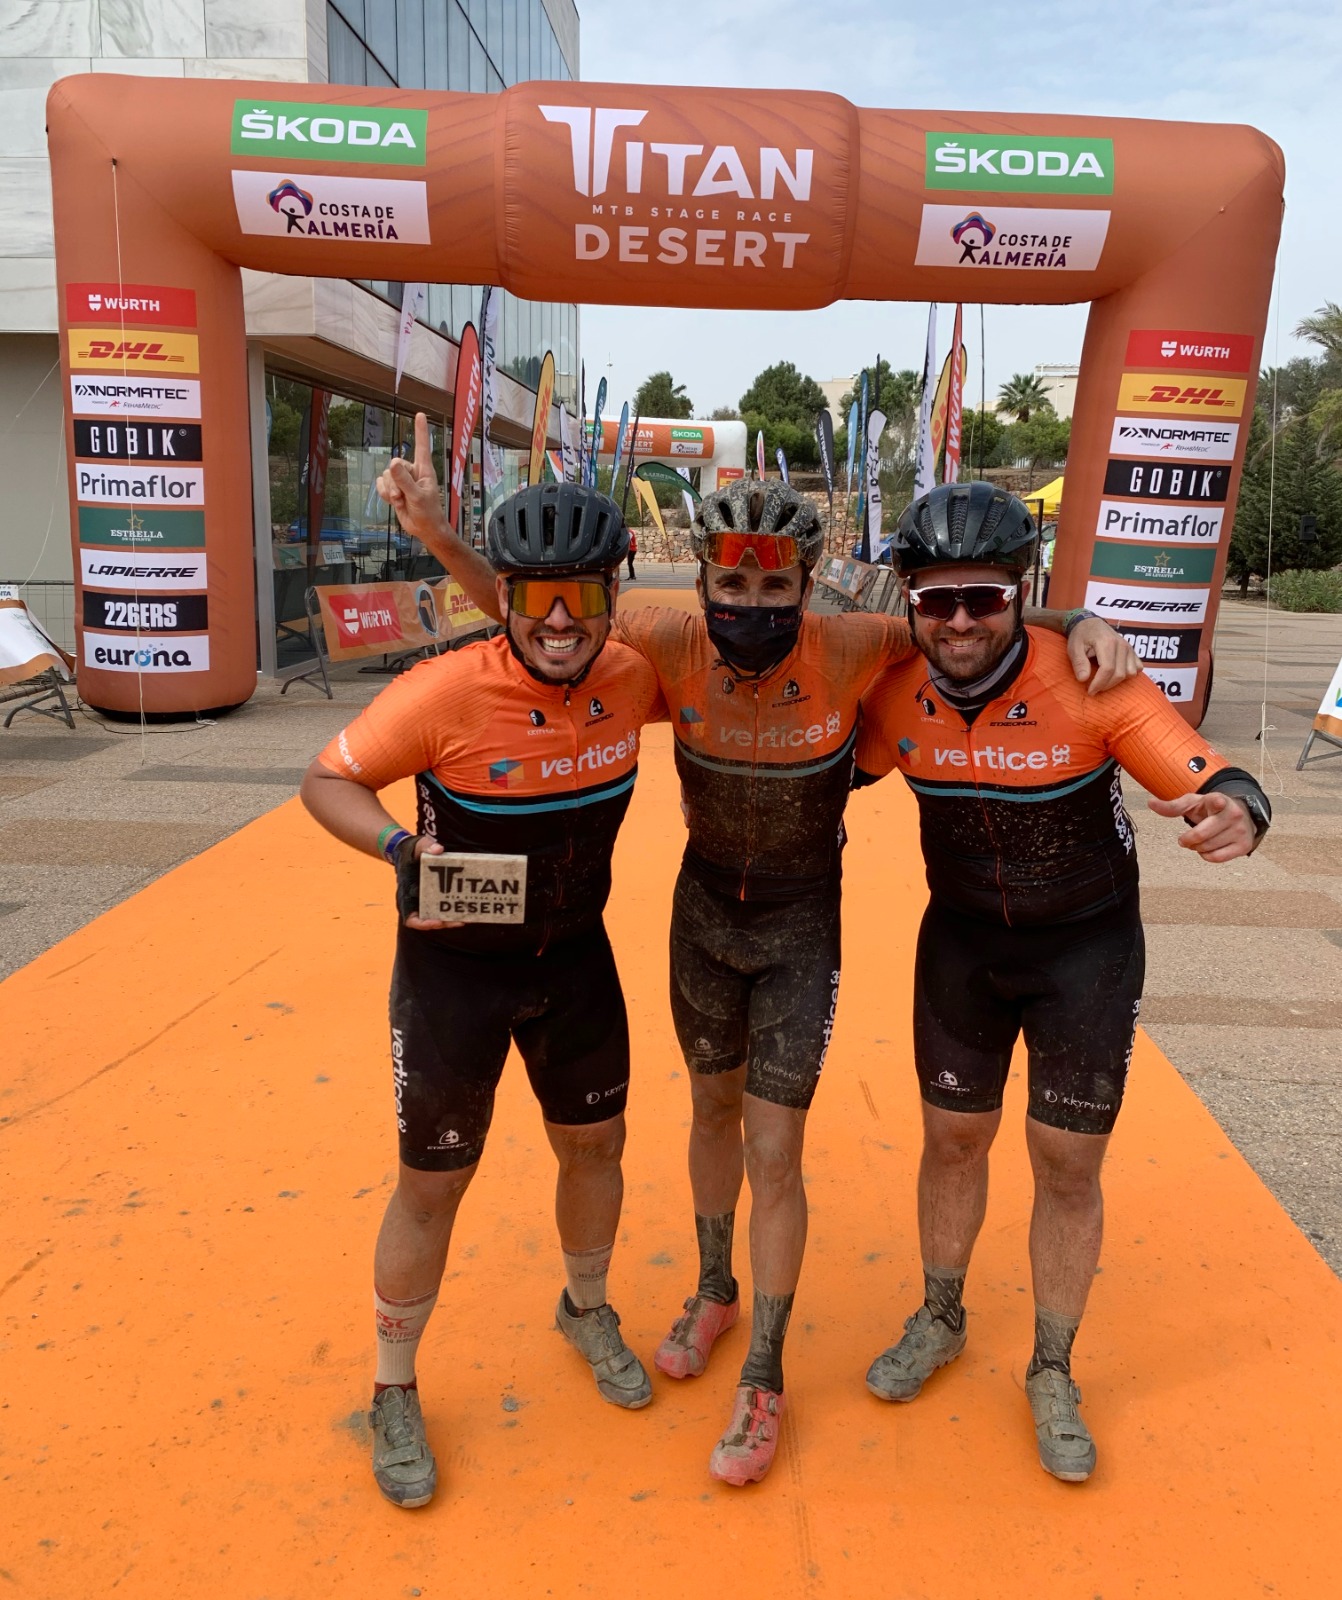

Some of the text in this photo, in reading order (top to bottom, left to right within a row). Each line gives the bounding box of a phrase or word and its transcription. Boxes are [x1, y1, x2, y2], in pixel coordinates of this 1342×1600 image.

[240, 108, 417, 149] ŠKODA
[537, 104, 814, 201] TITAN
[934, 142, 1105, 178] ŠKODA
[319, 203, 394, 219] COSTA DE
[592, 204, 792, 223] MTB STAGE RACE
[307, 219, 399, 240] ALMERÍA
[574, 223, 811, 269] DESERT
[998, 233, 1072, 248] COSTA DE
[978, 248, 1067, 268] ALMERÍA
[104, 297, 160, 312] WÜRTH
[88, 341, 169, 362] DHL
[1179, 344, 1230, 359] WÜRTH
[96, 385, 187, 400] NORMATEC
[1147, 385, 1226, 406] DHL
[90, 426, 176, 456] GOBIK
[1148, 428, 1231, 443] NORMATEC
[81, 472, 196, 498] Primaflor
[1129, 467, 1214, 497] GOBIK
[1104, 509, 1218, 537] Primaflor
[110, 529, 164, 539] ESTRELLA
[88, 563, 198, 578] LAPIERRE
[1133, 565, 1184, 575] ESTRELLA
[104, 601, 177, 628] 226ERS
[1096, 597, 1203, 612] LAPIERRE
[94, 645, 192, 668] eurona
[428, 866, 520, 895] TITAN
[440, 901, 519, 915] DESERT
